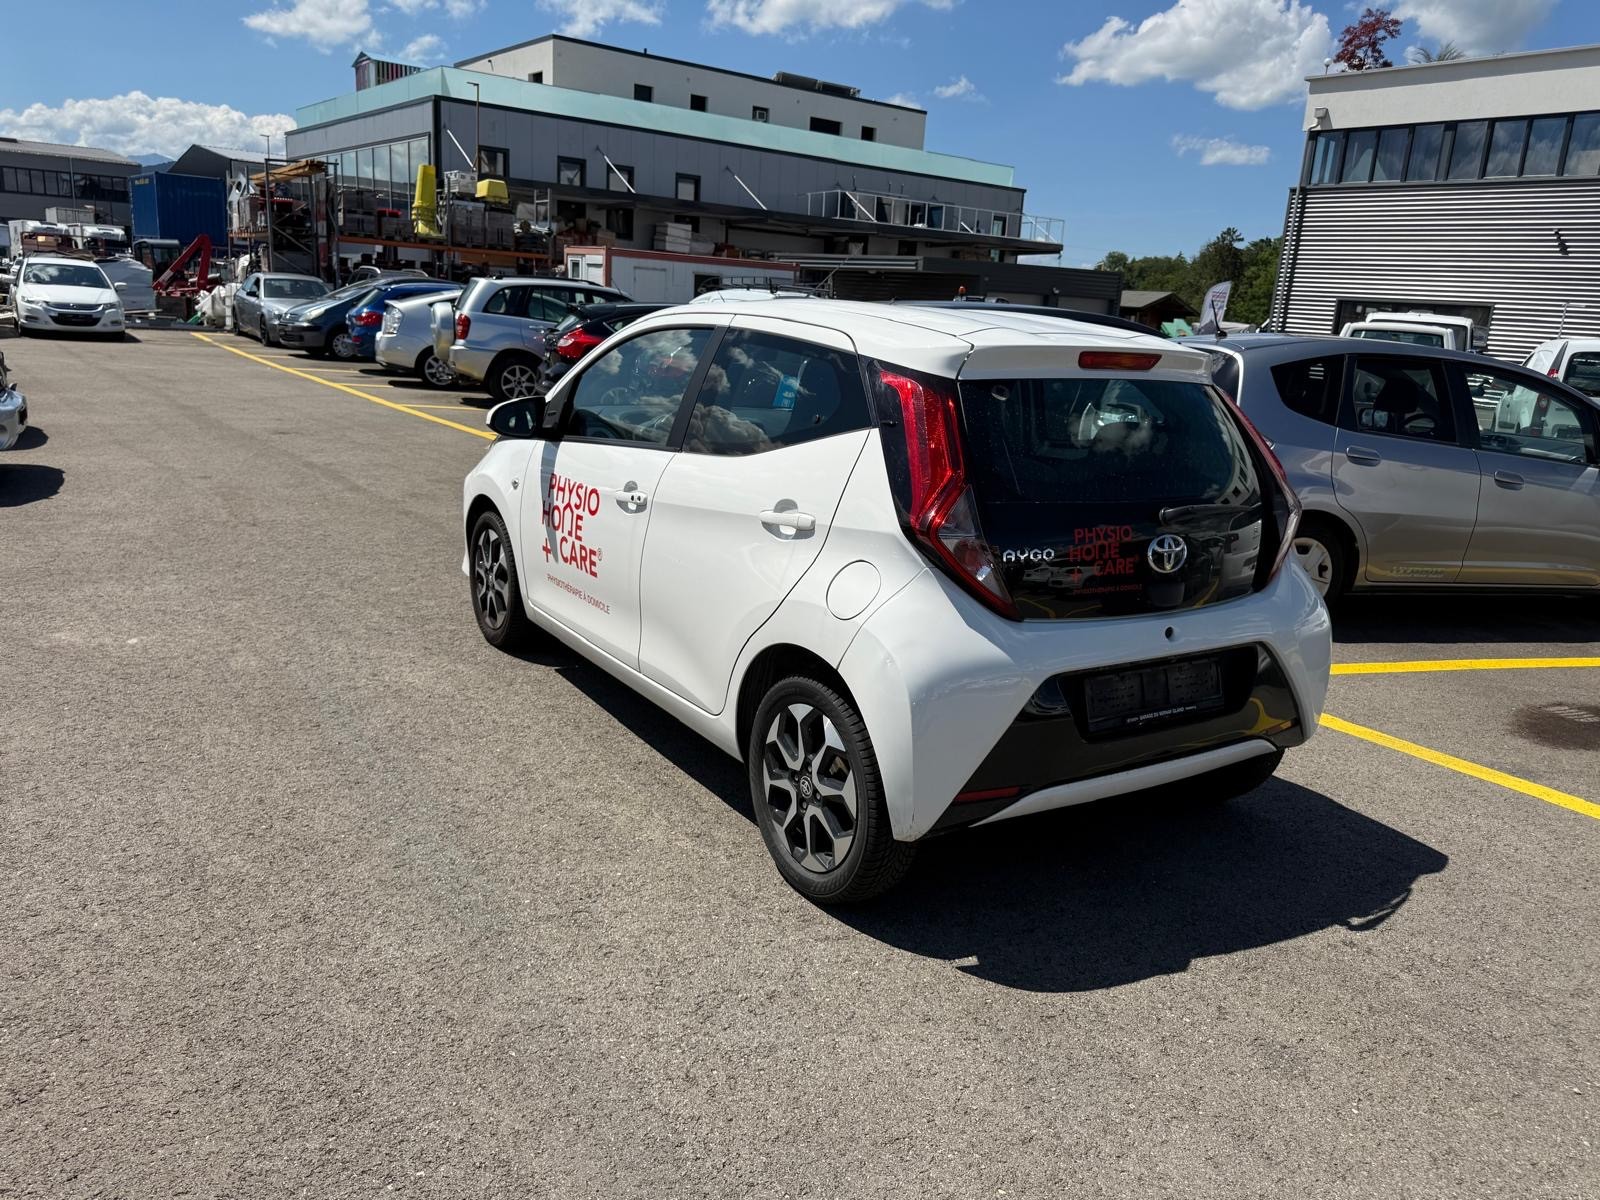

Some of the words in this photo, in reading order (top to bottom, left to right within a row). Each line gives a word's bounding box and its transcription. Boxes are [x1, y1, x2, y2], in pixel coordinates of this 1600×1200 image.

[548, 472, 600, 516] PHYSIO
[1073, 525, 1133, 544] PHYSIO
[1002, 548, 1055, 562] AYGO
